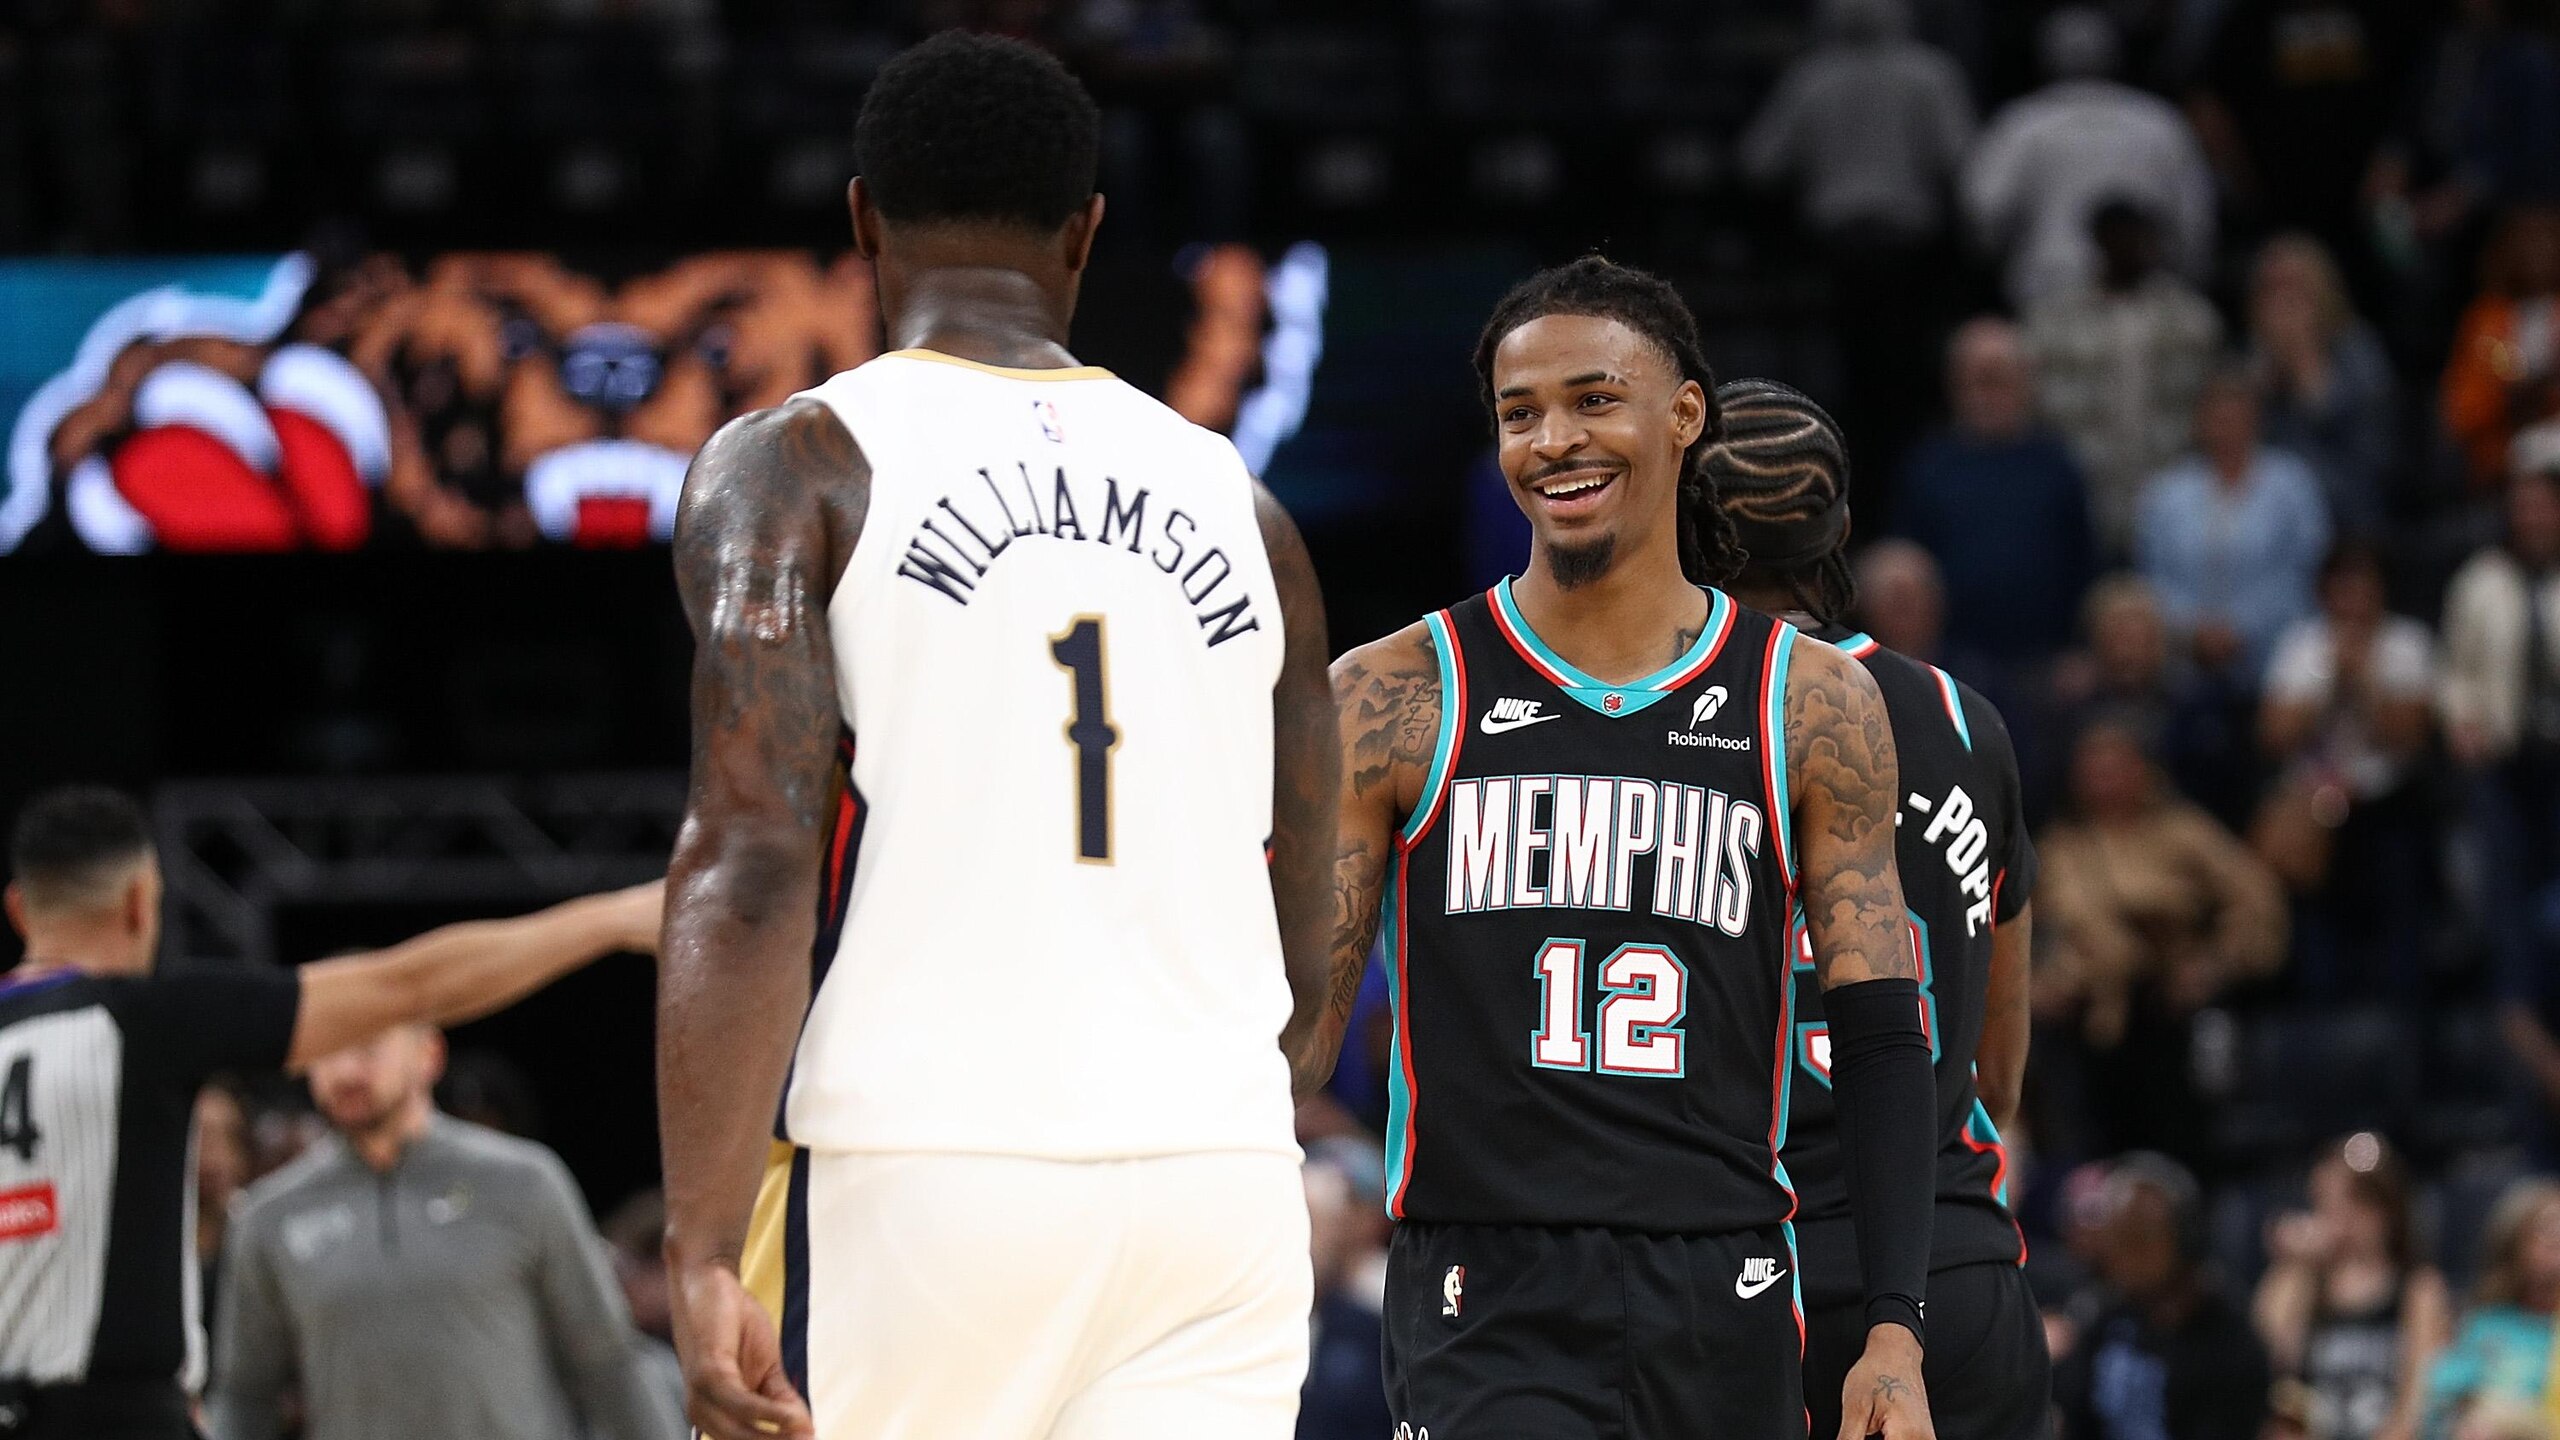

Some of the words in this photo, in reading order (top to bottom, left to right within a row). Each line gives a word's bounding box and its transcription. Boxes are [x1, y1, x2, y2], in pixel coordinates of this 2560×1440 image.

[897, 462, 1260, 649] WILLIAMSON
[1046, 613, 1123, 866] 1
[1490, 697, 1542, 720] NIKE
[1667, 730, 1751, 751] Robinhood
[1445, 774, 1763, 938] MEMPHIS
[1895, 784, 1993, 938] -POPE
[1531, 937, 1689, 1079] 12
[1742, 1257, 1776, 1282] NIKE
